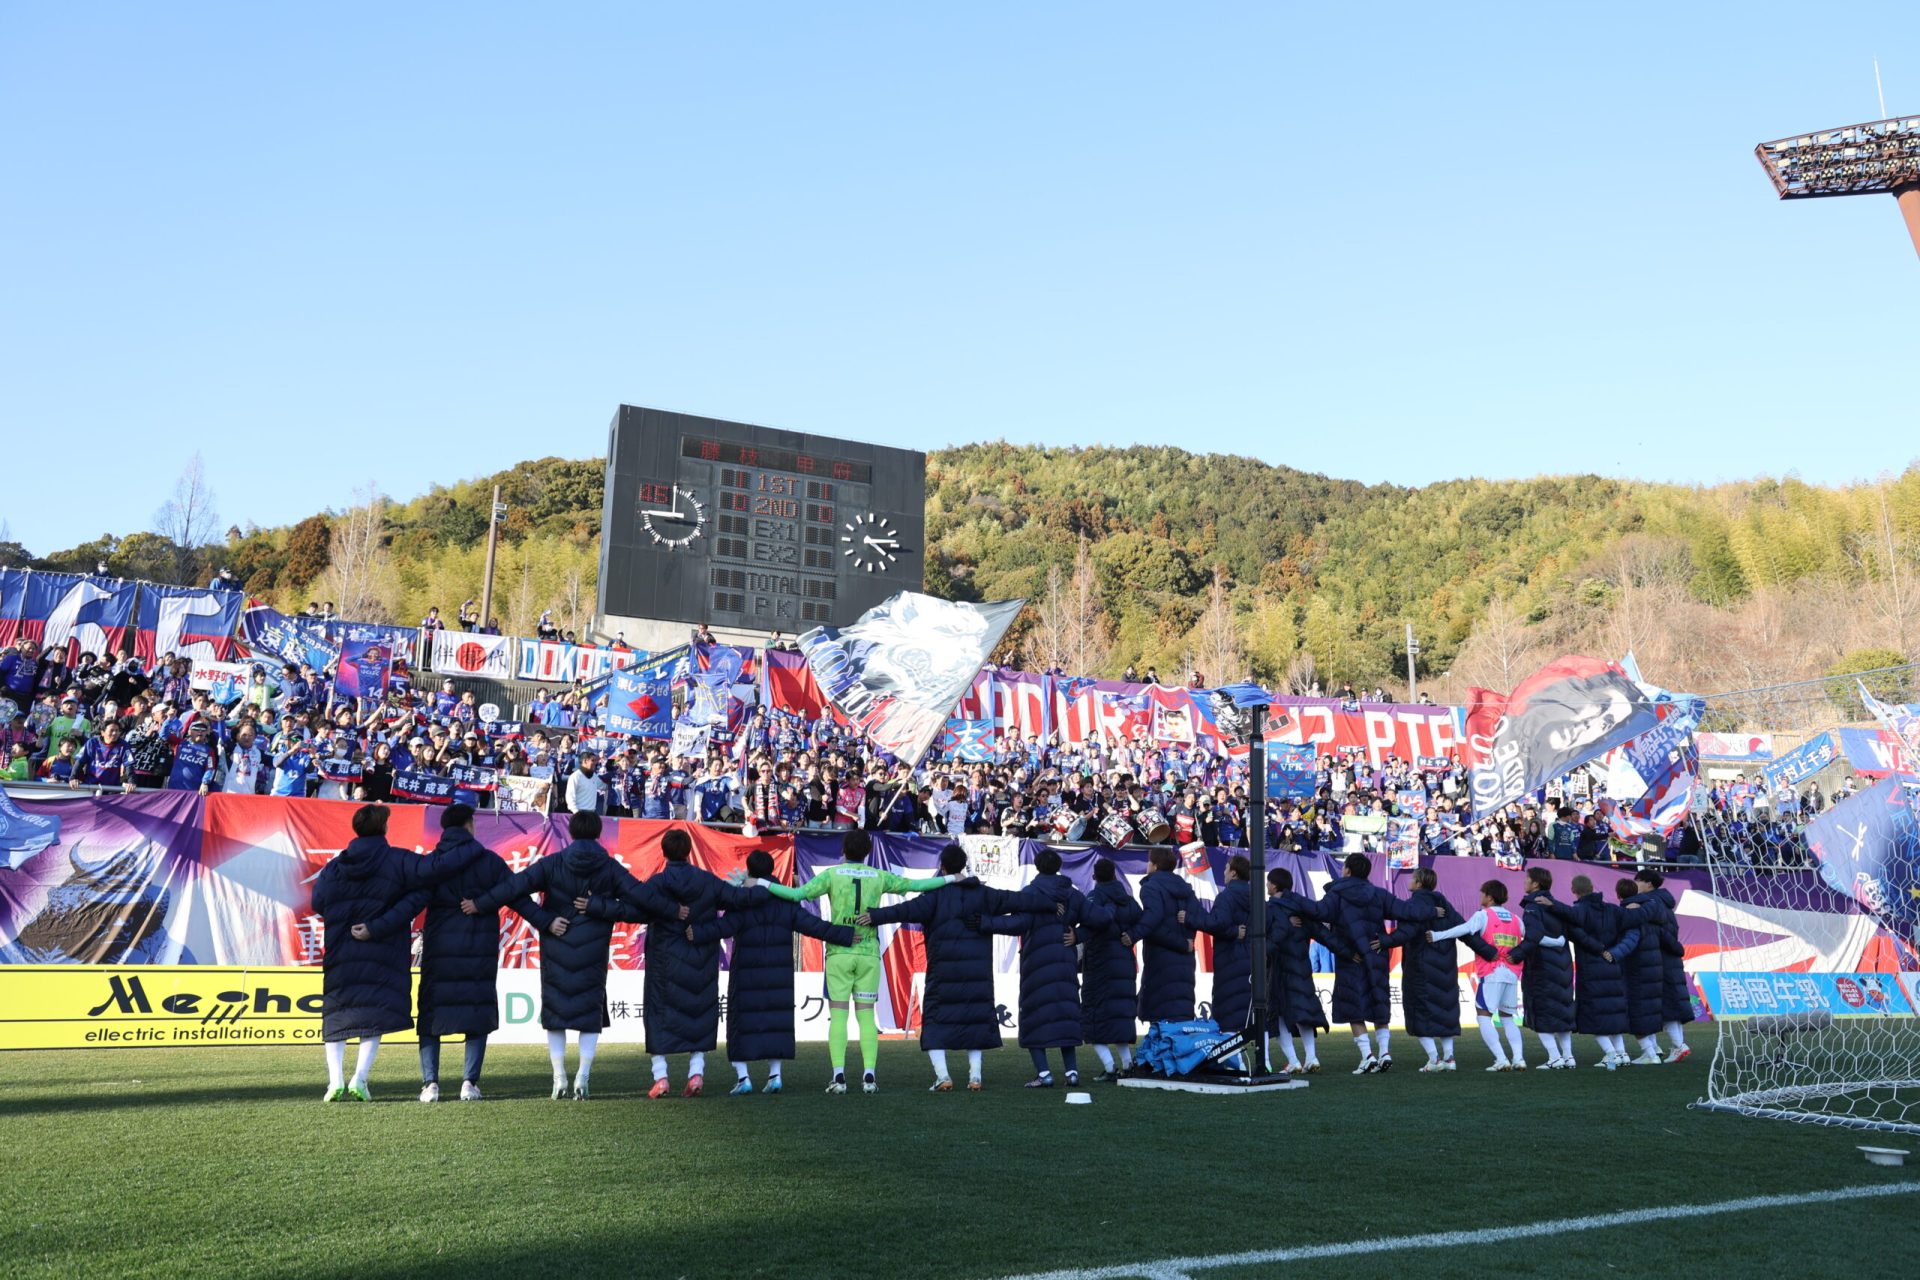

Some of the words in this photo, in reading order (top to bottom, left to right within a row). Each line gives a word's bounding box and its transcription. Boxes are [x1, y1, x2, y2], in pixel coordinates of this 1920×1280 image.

[758, 473, 800, 496] 1ST
[754, 496, 798, 518] 2ND
[755, 520, 795, 541] EX1
[755, 542, 799, 565] EX2
[746, 571, 801, 596] TOTAL
[280, 619, 297, 635] The
[368, 686, 383, 699] 14
[1280, 763, 1304, 771] VFK
[397, 777, 420, 791] 武井
[852, 878, 862, 915] 1
[1718, 977, 1831, 1009] 静岡牛乳
[505, 992, 541, 1025] D
[85, 1028, 166, 1042] ellectric
[173, 1026, 285, 1041] installations
